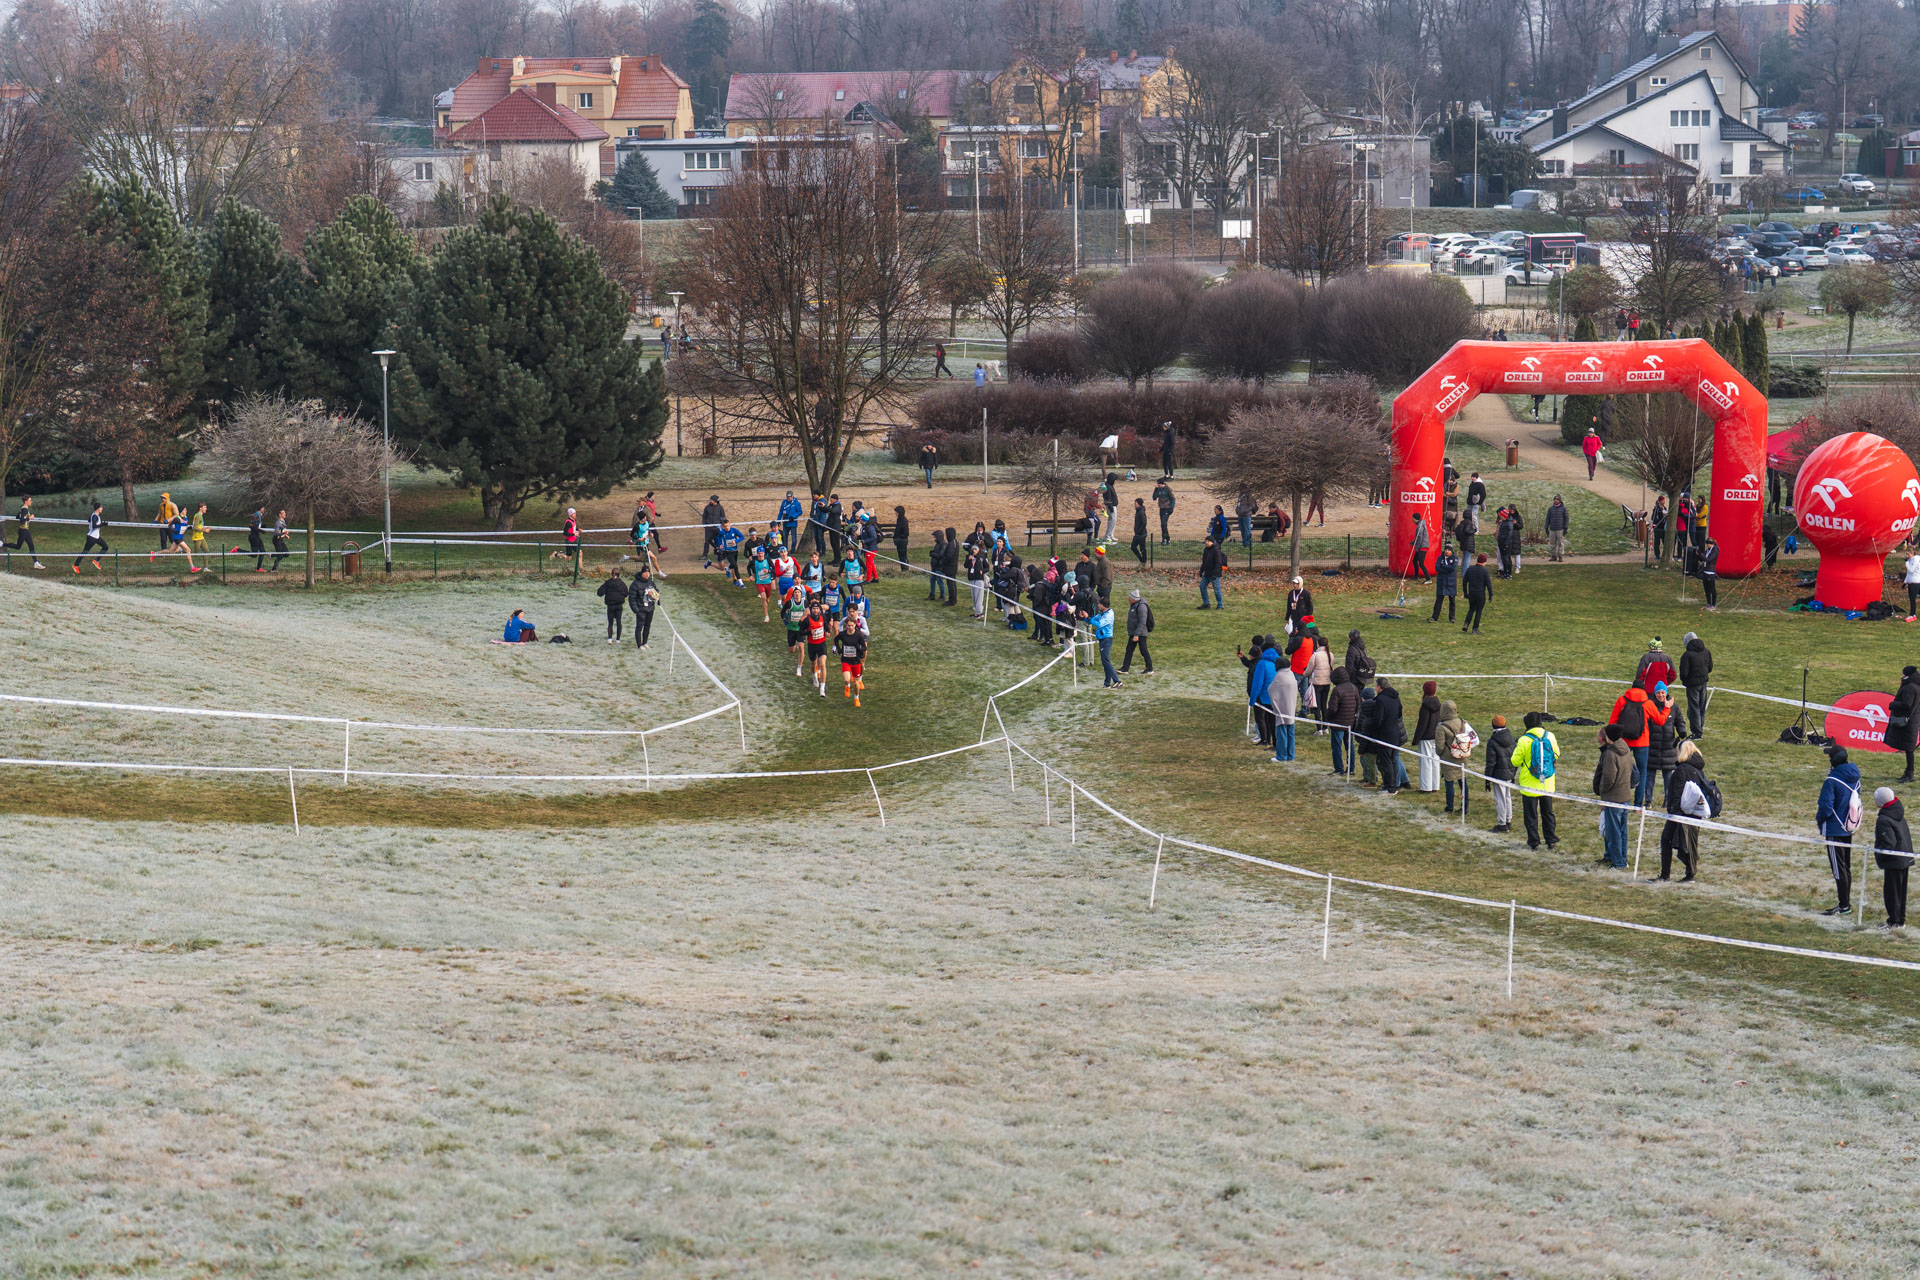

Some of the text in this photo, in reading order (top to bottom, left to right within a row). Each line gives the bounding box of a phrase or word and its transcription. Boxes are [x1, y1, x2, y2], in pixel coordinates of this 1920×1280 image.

[1629, 372, 1662, 380] ORLEN
[1438, 384, 1467, 411] ORLEN
[1701, 382, 1730, 408] ORLEN
[1402, 493, 1433, 502] ORLEN
[1726, 491, 1757, 499] ORLEN
[1805, 513, 1856, 532] ORLEN
[1849, 729, 1886, 742] ORLEN
